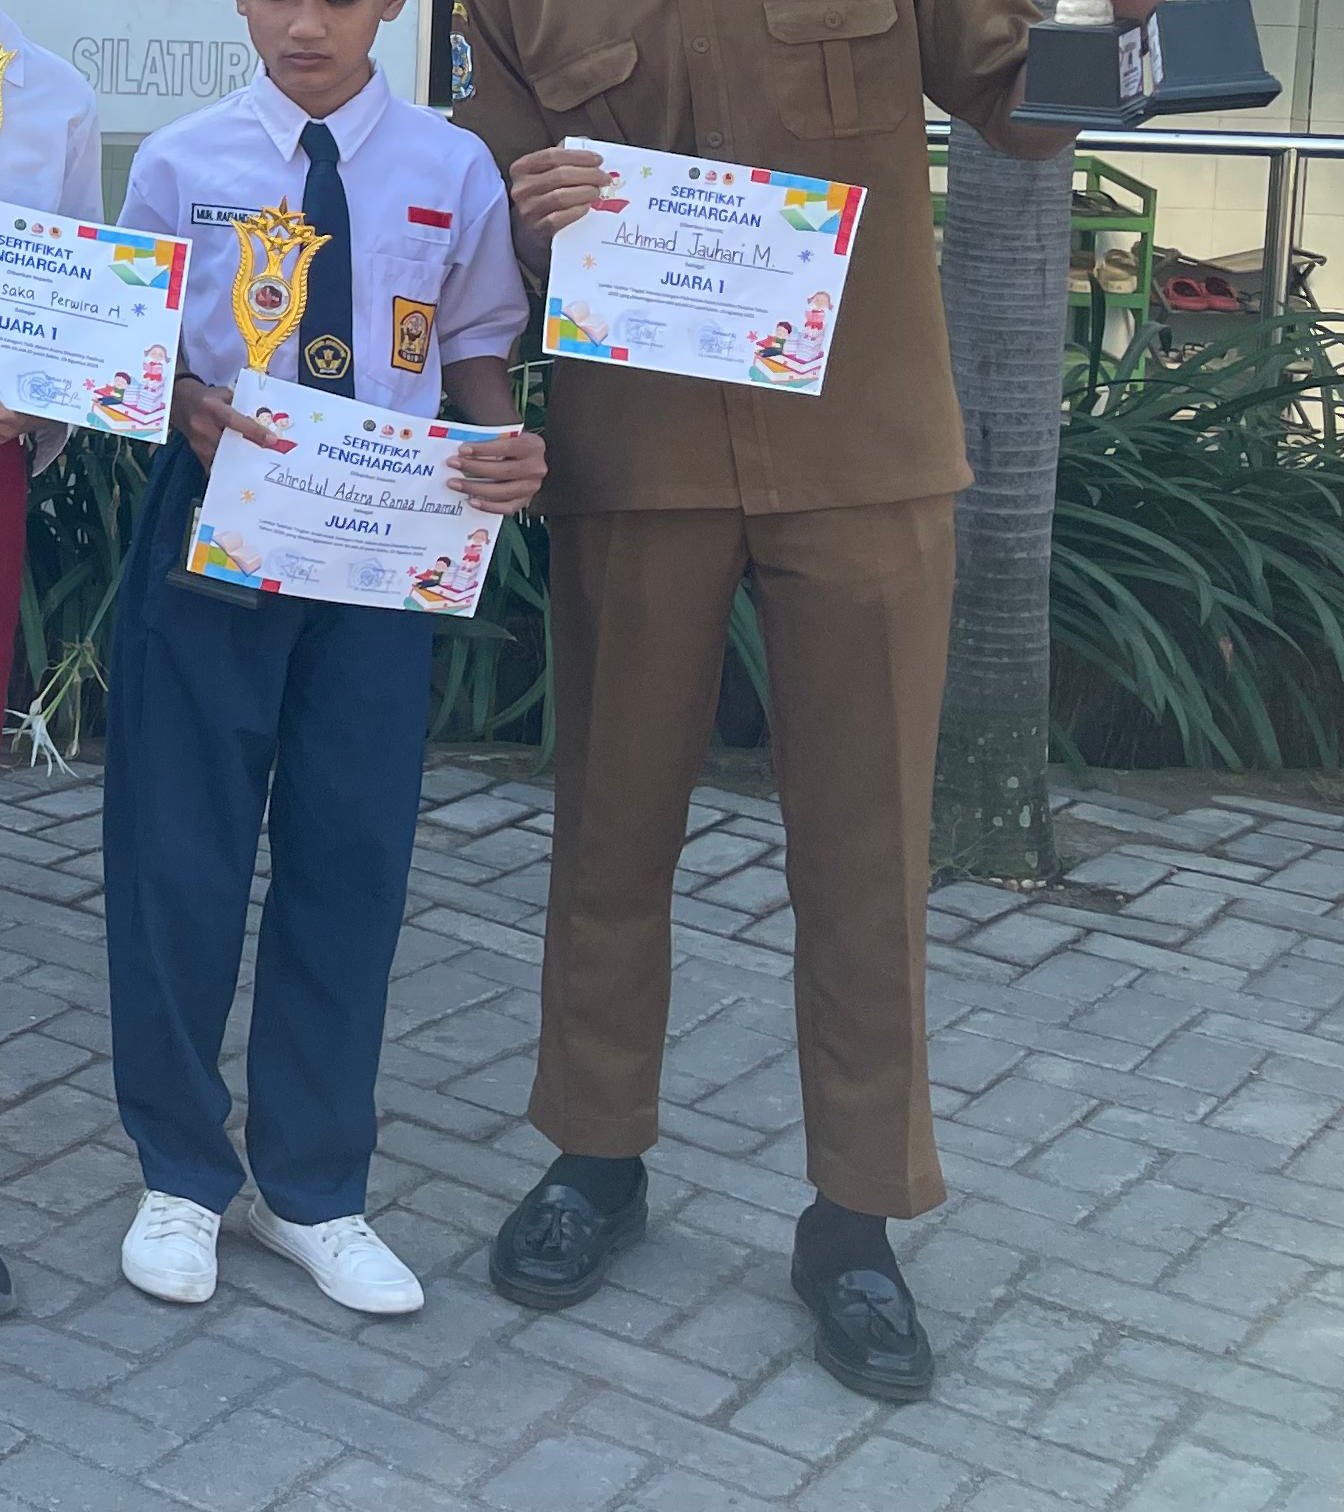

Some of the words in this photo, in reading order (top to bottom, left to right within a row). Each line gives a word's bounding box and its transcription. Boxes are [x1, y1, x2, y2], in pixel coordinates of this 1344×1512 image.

[72, 36, 260, 98] SILATUR
[670, 185, 746, 208] SERTIFIKAT
[648, 197, 762, 228] PENGHARGAAN
[614, 221, 678, 252] Achmad
[687, 232, 745, 264] Jauhari
[660, 271, 713, 293] JUARA
[50, 291, 99, 314] Perwira
[317, 443, 434, 477] PENGHARGAAN
[342, 435, 420, 460] SERTIFIKAT
[324, 515, 379, 535] JUARA
